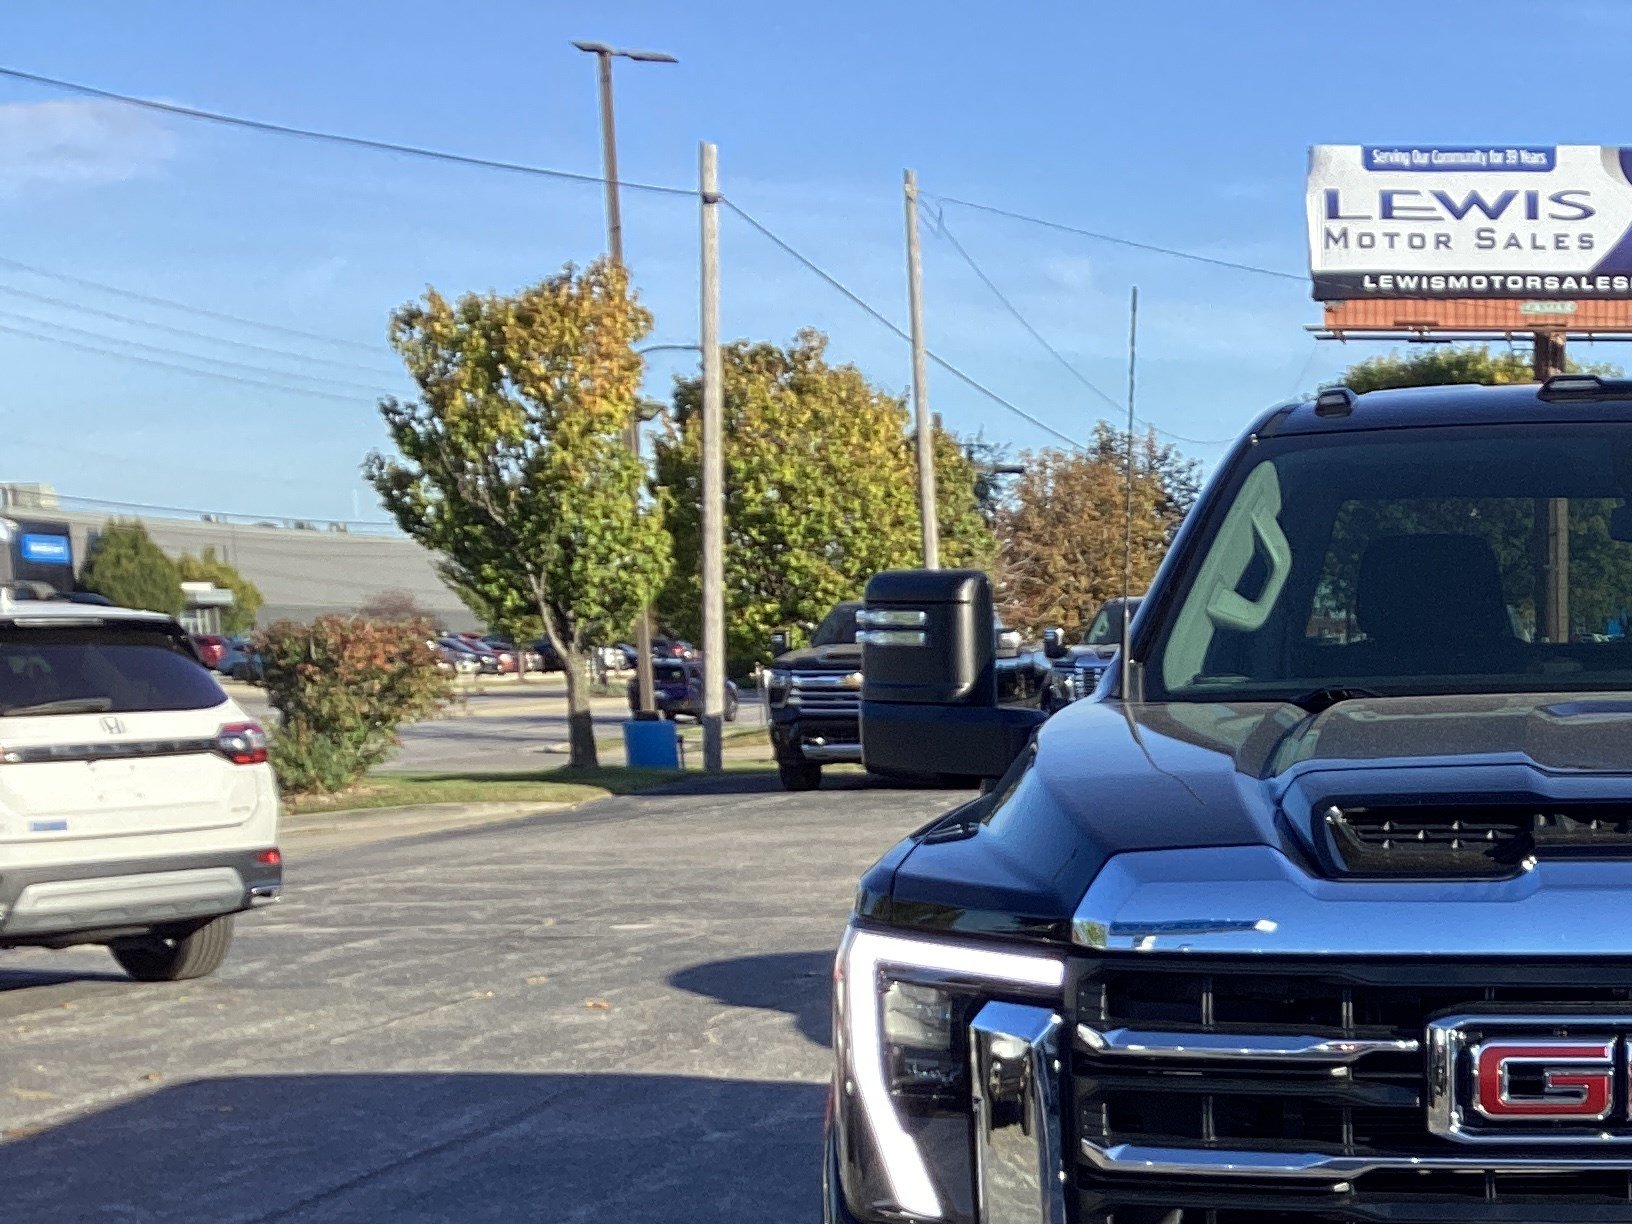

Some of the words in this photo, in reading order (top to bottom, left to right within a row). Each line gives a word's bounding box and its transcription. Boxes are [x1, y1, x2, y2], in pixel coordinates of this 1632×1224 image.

[1372, 149, 1410, 167] Serving
[1412, 149, 1430, 164] Our
[1431, 149, 1487, 167] Community
[1489, 149, 1504, 164] for
[1324, 188, 1596, 220] LEWIS
